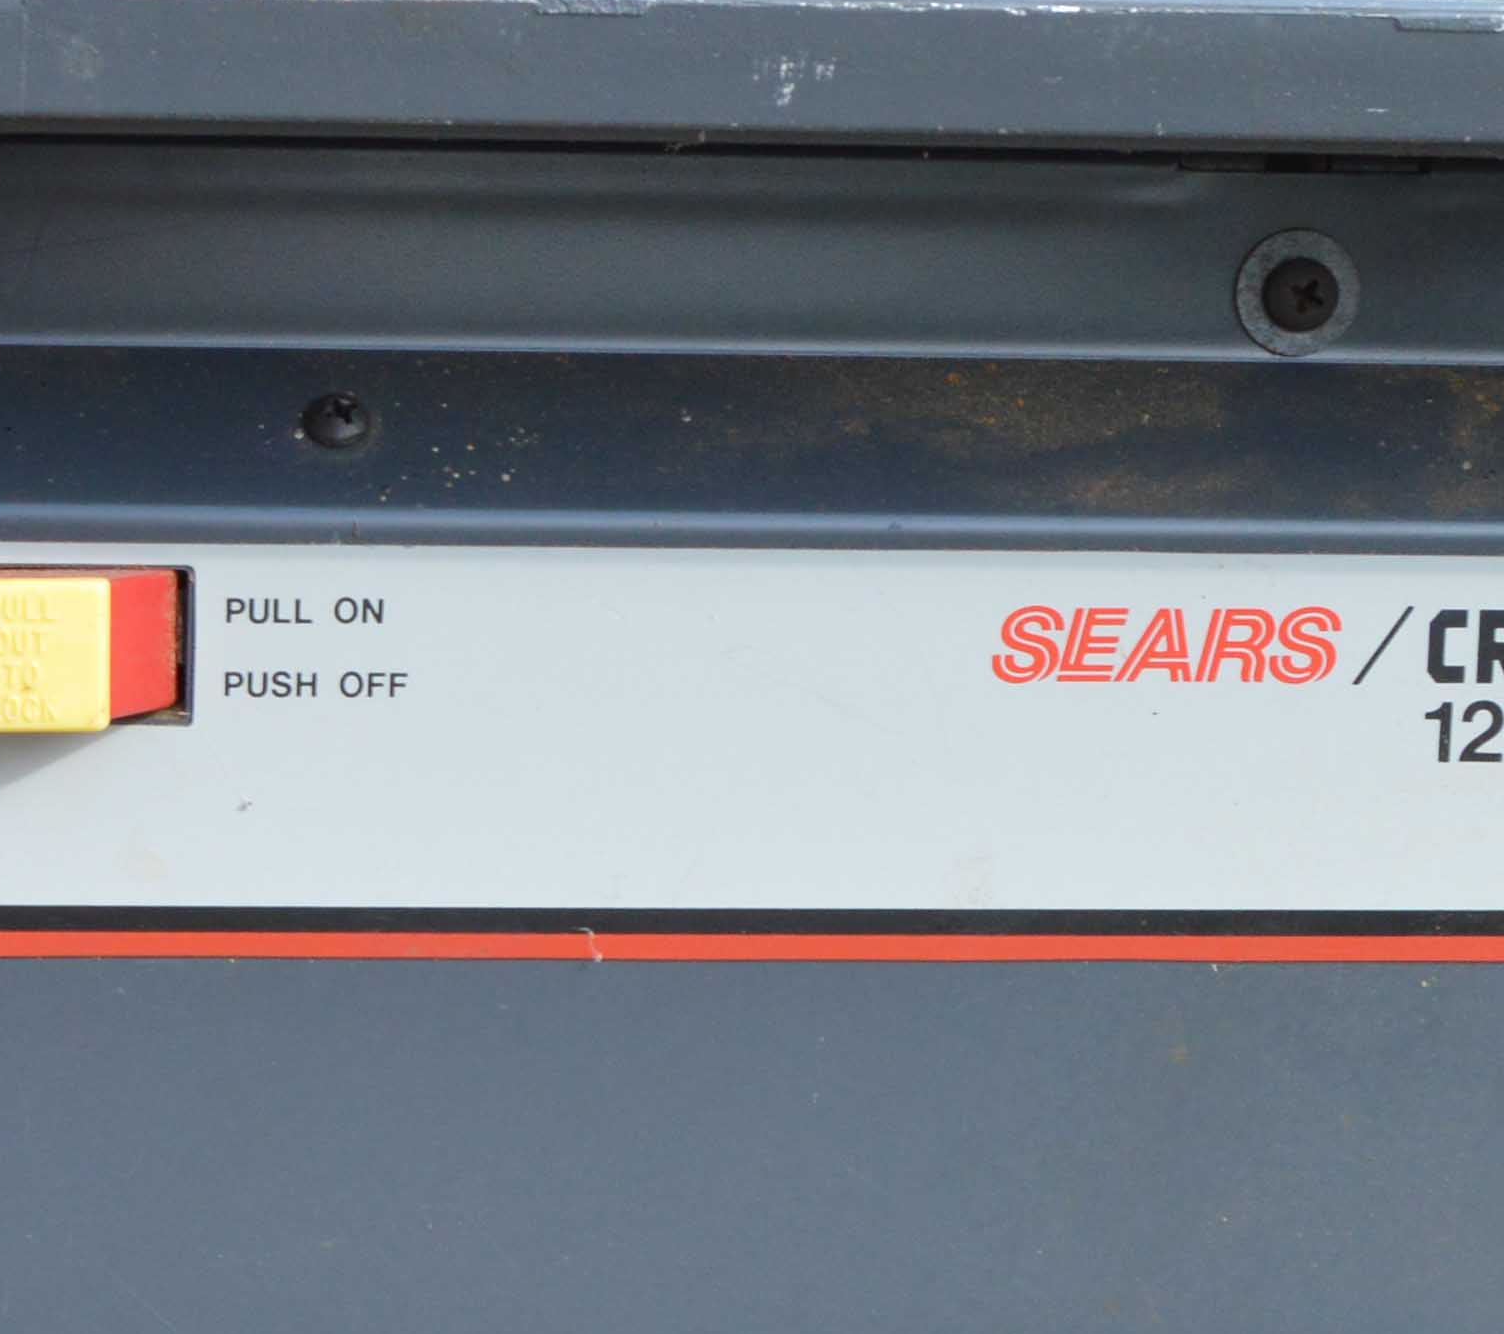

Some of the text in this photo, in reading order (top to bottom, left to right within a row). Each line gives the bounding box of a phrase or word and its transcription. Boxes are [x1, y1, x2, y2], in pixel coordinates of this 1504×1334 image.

[225, 596, 385, 625] PULL ON
[1, 661, 41, 691] TO
[223, 670, 409, 699] PUSH OFF
